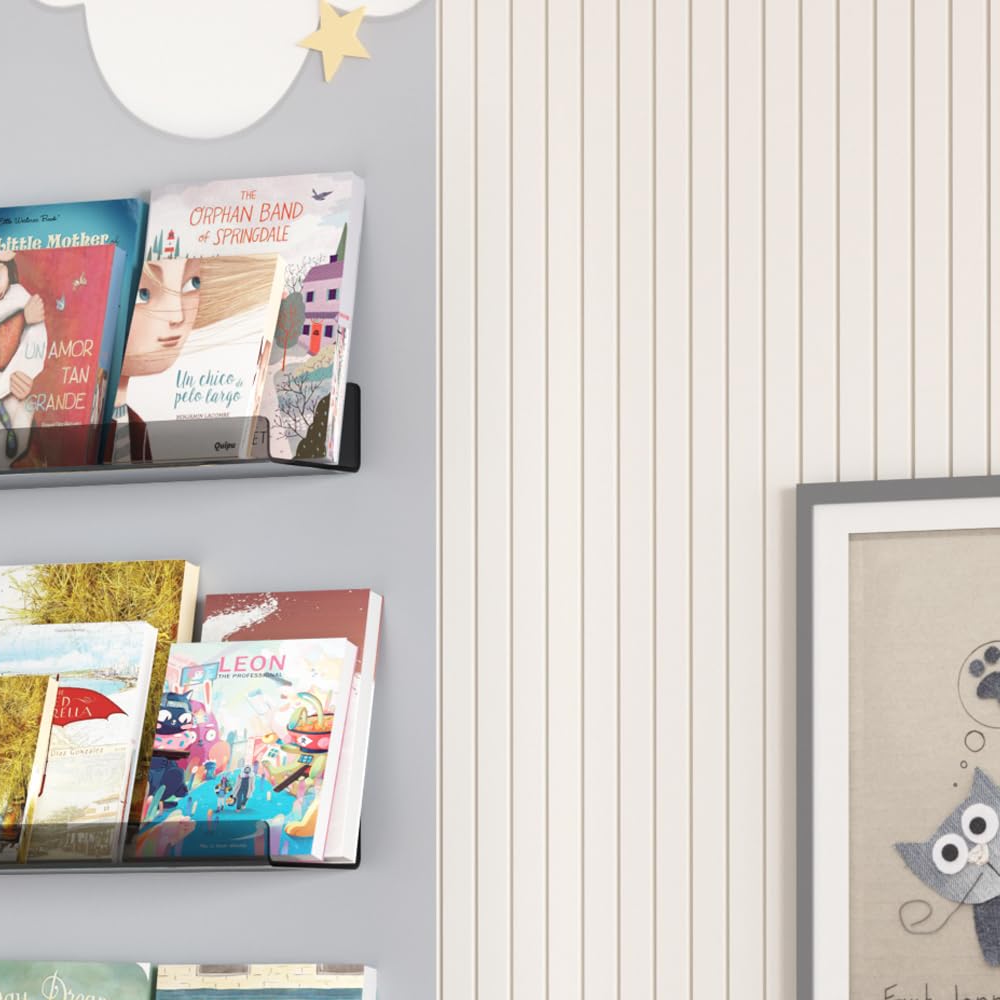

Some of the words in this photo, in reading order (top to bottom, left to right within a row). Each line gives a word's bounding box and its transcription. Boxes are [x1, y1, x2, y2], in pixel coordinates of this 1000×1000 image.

[240, 190, 257, 200] THE
[189, 206, 254, 227] ORPHAN
[259, 201, 304, 222] BAND
[46, 232, 110, 248] Mother
[198, 231, 211, 243] of
[213, 225, 291, 246] SPRINGDALE
[25, 342, 45, 360] UN
[48, 339, 94, 359] AMOR
[62, 365, 90, 384] TAN
[176, 369, 194, 389] Un
[199, 370, 235, 387] chico
[24, 392, 87, 412] GRANDE
[174, 388, 203, 409] pelo
[206, 388, 242, 409] largo
[219, 654, 287, 673] LEON
